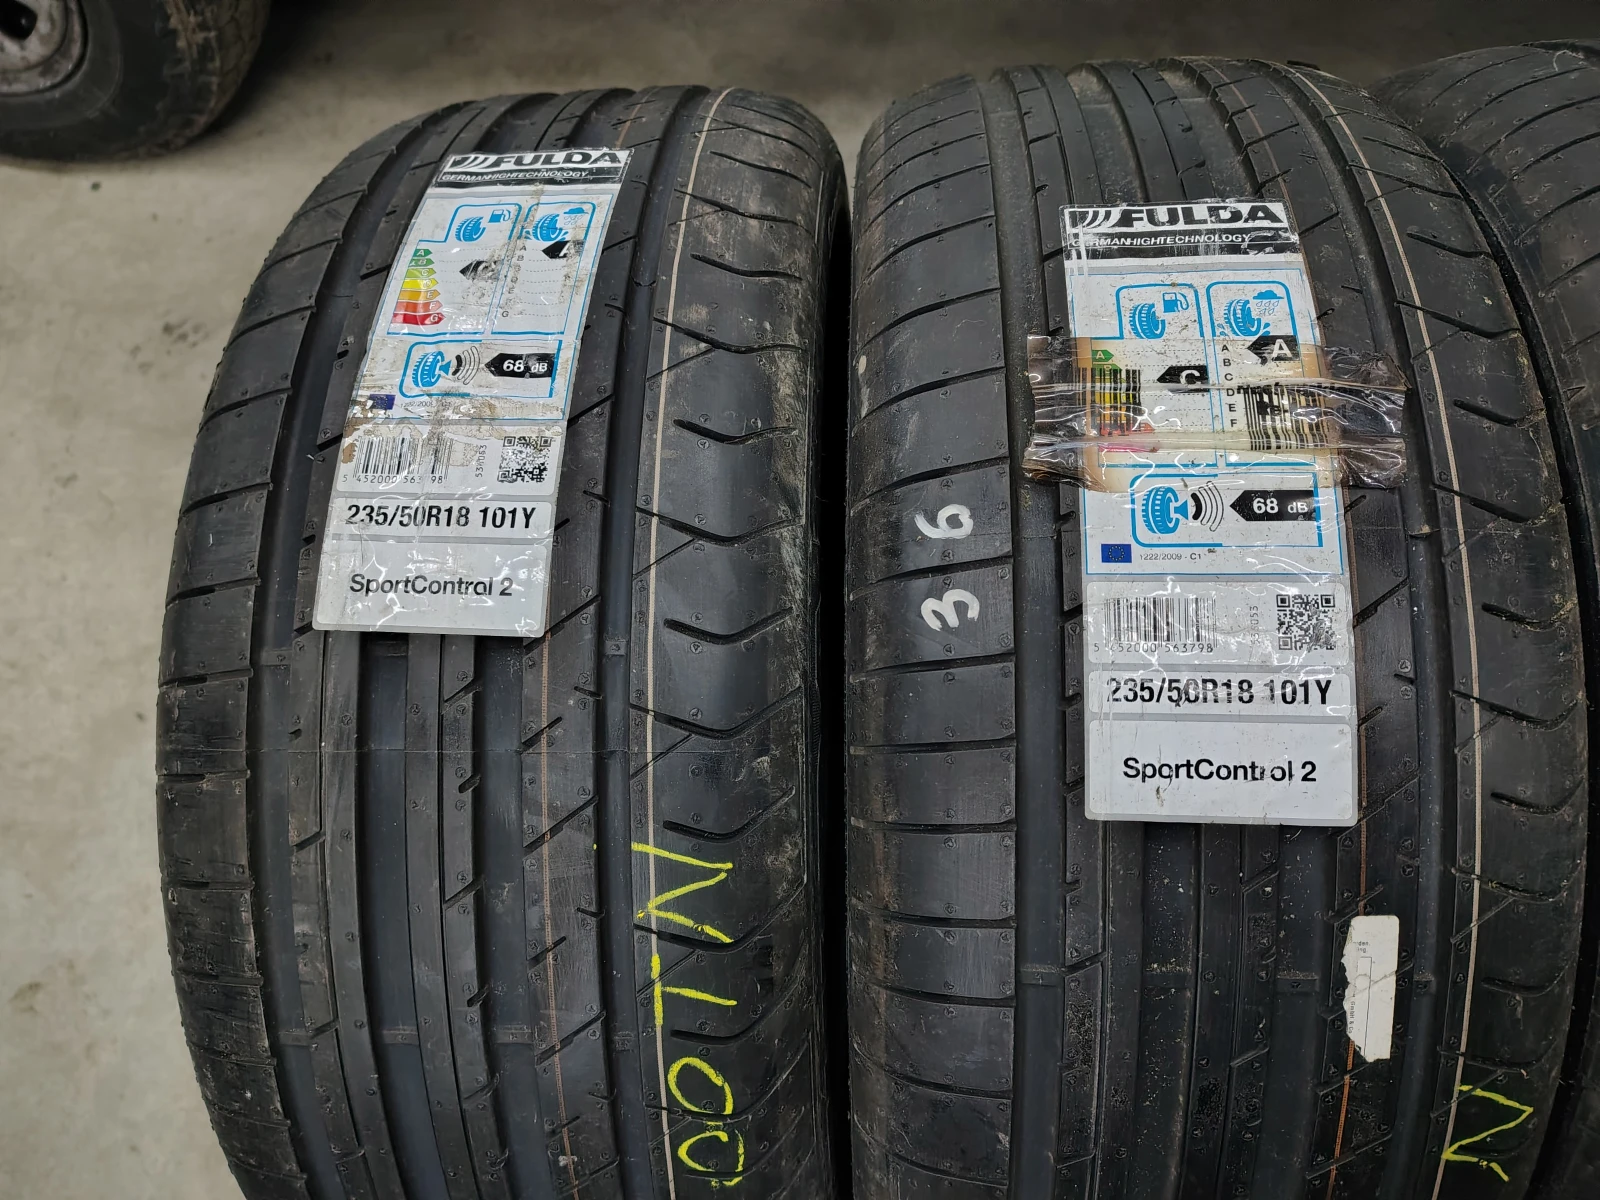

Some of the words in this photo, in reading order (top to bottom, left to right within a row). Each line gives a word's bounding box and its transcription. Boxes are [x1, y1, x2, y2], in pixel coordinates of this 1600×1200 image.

[484, 151, 622, 170] FULDA
[1110, 204, 1284, 228] FULDA
[416, 249, 425, 257] A
[426, 291, 434, 299] E
[428, 301, 437, 310] F
[430, 314, 439, 323] G
[1221, 344, 1230, 352] A
[1272, 338, 1293, 358] A
[1095, 350, 1105, 360] A
[502, 359, 525, 372] 68
[531, 362, 549, 373] dB
[1223, 358, 1232, 367] B
[1180, 369, 1201, 385] C
[1224, 372, 1234, 382] C
[1226, 388, 1235, 397] D
[1228, 403, 1237, 412] E
[1230, 418, 1239, 428] F
[403, 475, 443, 484] 56398
[1252, 497, 1279, 513] 68
[1287, 502, 1309, 513] dB
[345, 504, 470, 528] 235/50R18
[480, 505, 536, 529] 101Y
[350, 573, 493, 597] SportControl
[499, 577, 514, 597] 2
[1106, 678, 1254, 705] 235/50R18
[1266, 679, 1332, 705] 101Y
[1123, 757, 1293, 783] SportControl
[1301, 760, 1317, 782] 2
